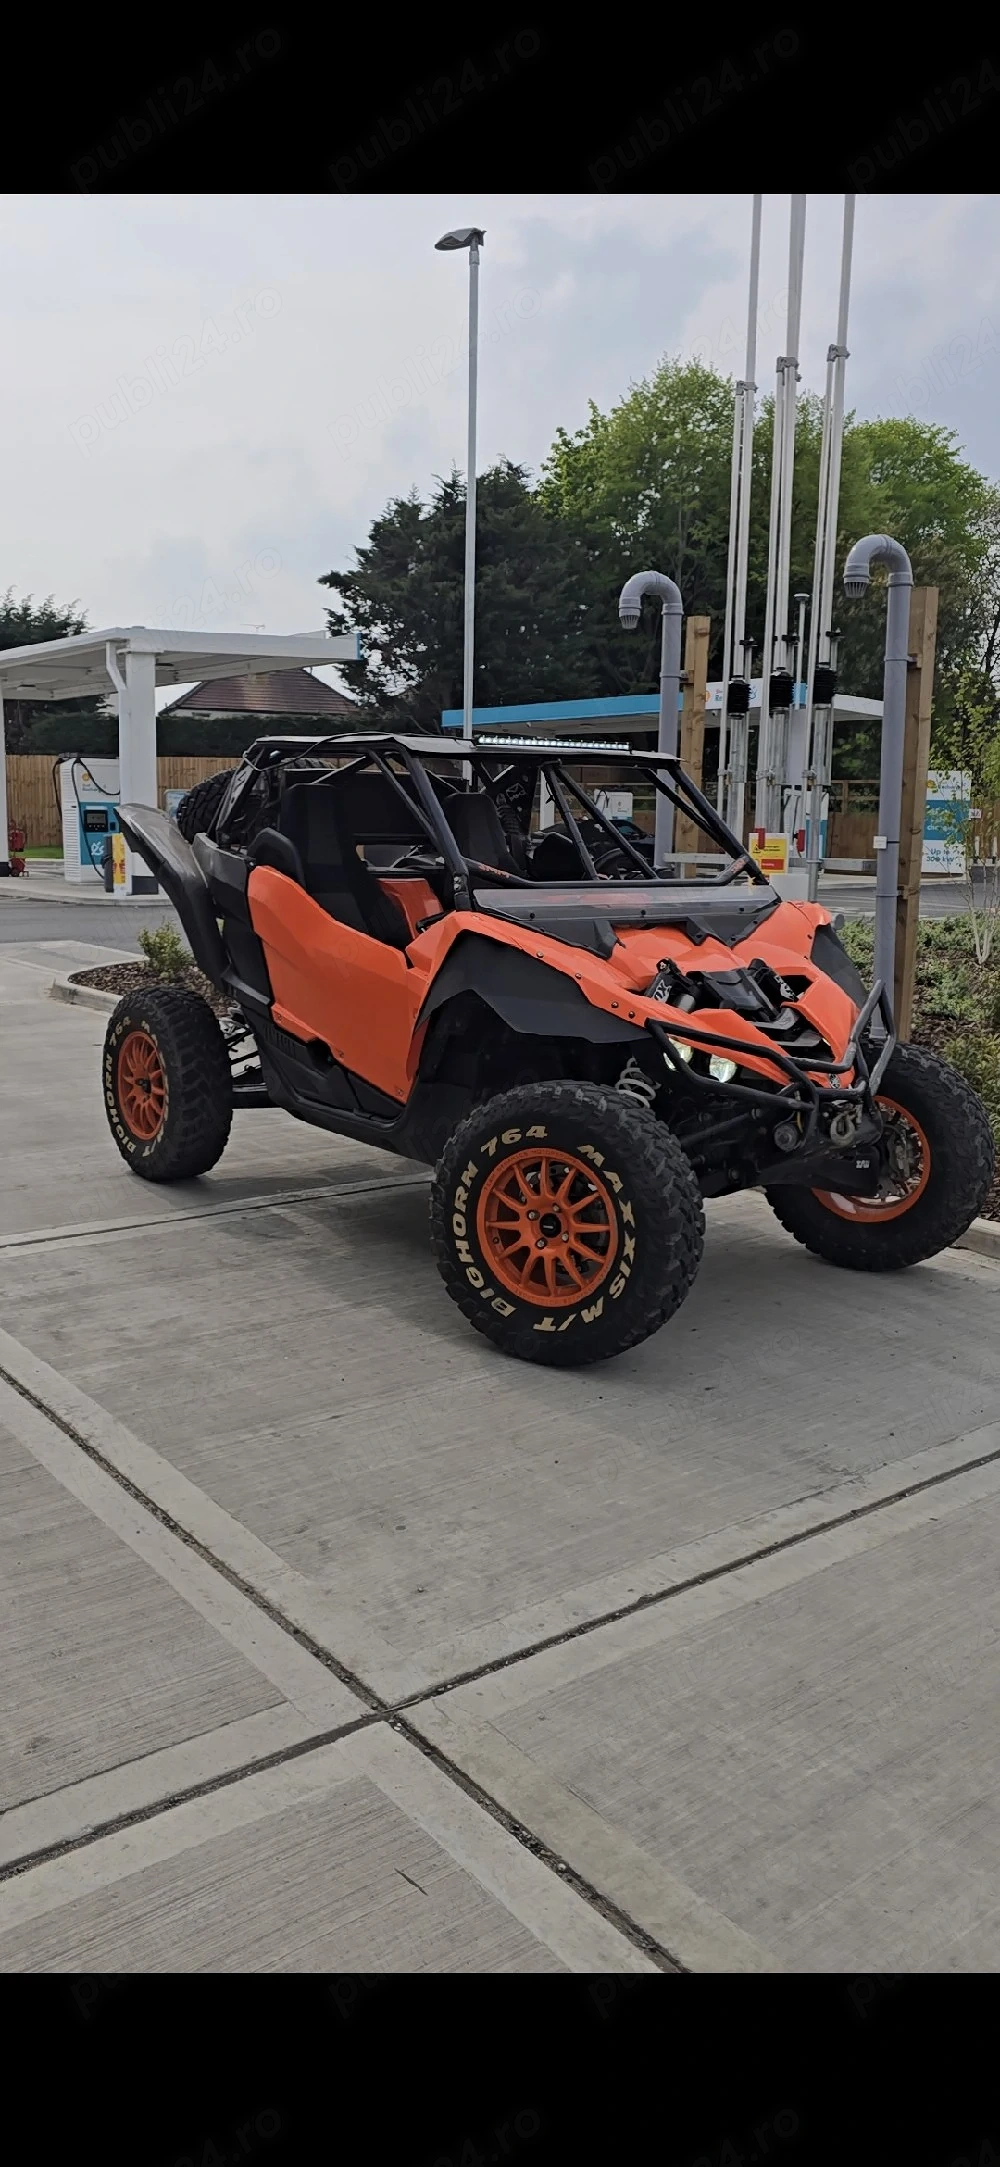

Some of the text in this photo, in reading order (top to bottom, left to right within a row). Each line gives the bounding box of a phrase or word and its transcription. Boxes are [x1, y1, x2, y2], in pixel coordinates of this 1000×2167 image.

[105, 1053, 137, 1153] BIGHORN
[480, 1125, 548, 1157] 764
[452, 1160, 517, 1318] BIGHORN
[576, 1144, 637, 1300] MAXXIS
[533, 1295, 605, 1332] M/T
